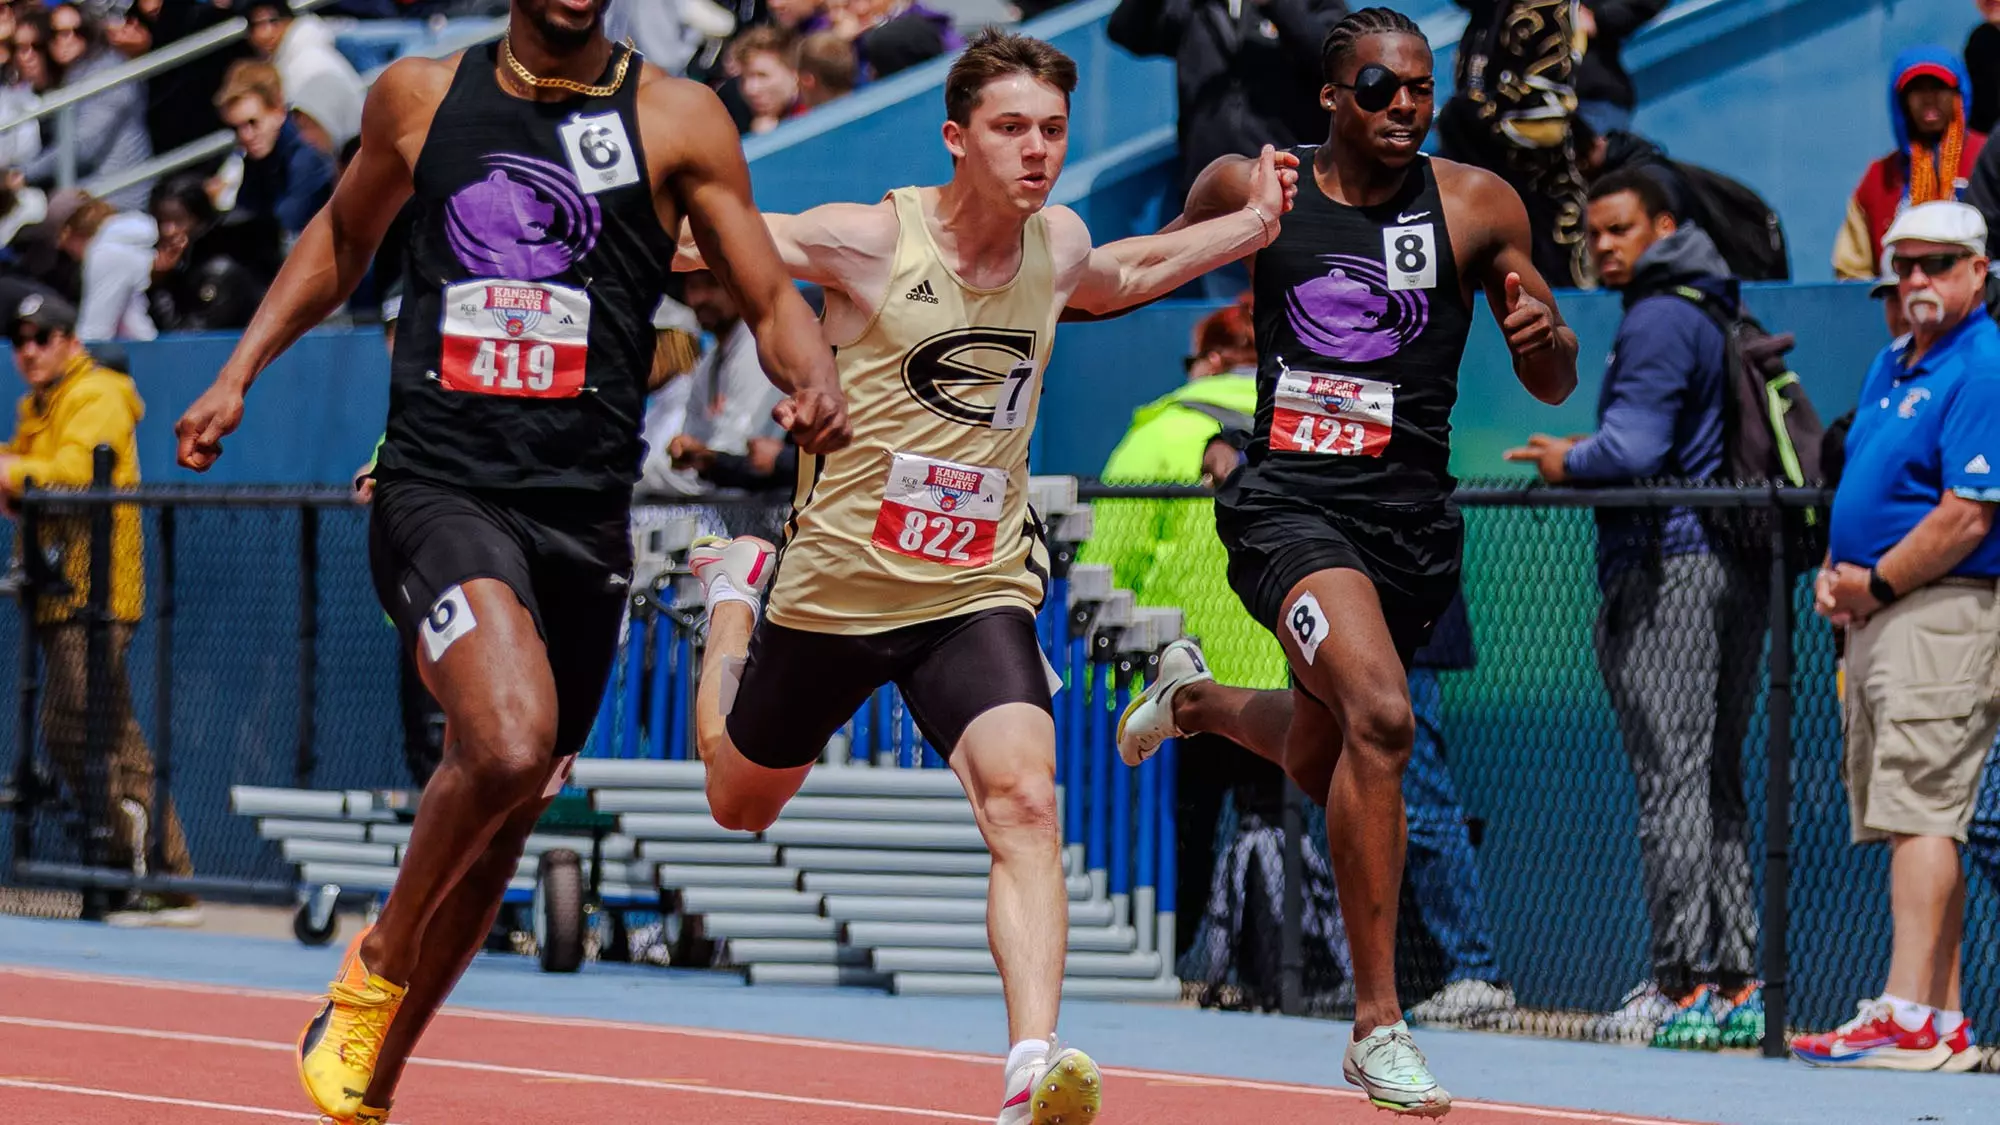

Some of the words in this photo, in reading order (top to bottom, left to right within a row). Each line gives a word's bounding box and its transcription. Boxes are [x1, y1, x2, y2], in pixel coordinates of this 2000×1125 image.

[579, 126, 621, 171] 6
[1394, 234, 1427, 273] 8
[493, 287, 544, 301] KANSAS
[493, 297, 542, 310] RELAYS
[905, 292, 939, 305] adidas
[472, 340, 555, 391] 419
[1006, 367, 1033, 411] 7
[1292, 415, 1365, 455] 423
[934, 477, 975, 491] RELAYS
[935, 467, 978, 483] KANSAS
[899, 511, 976, 560] 822
[1293, 605, 1316, 644] 8
